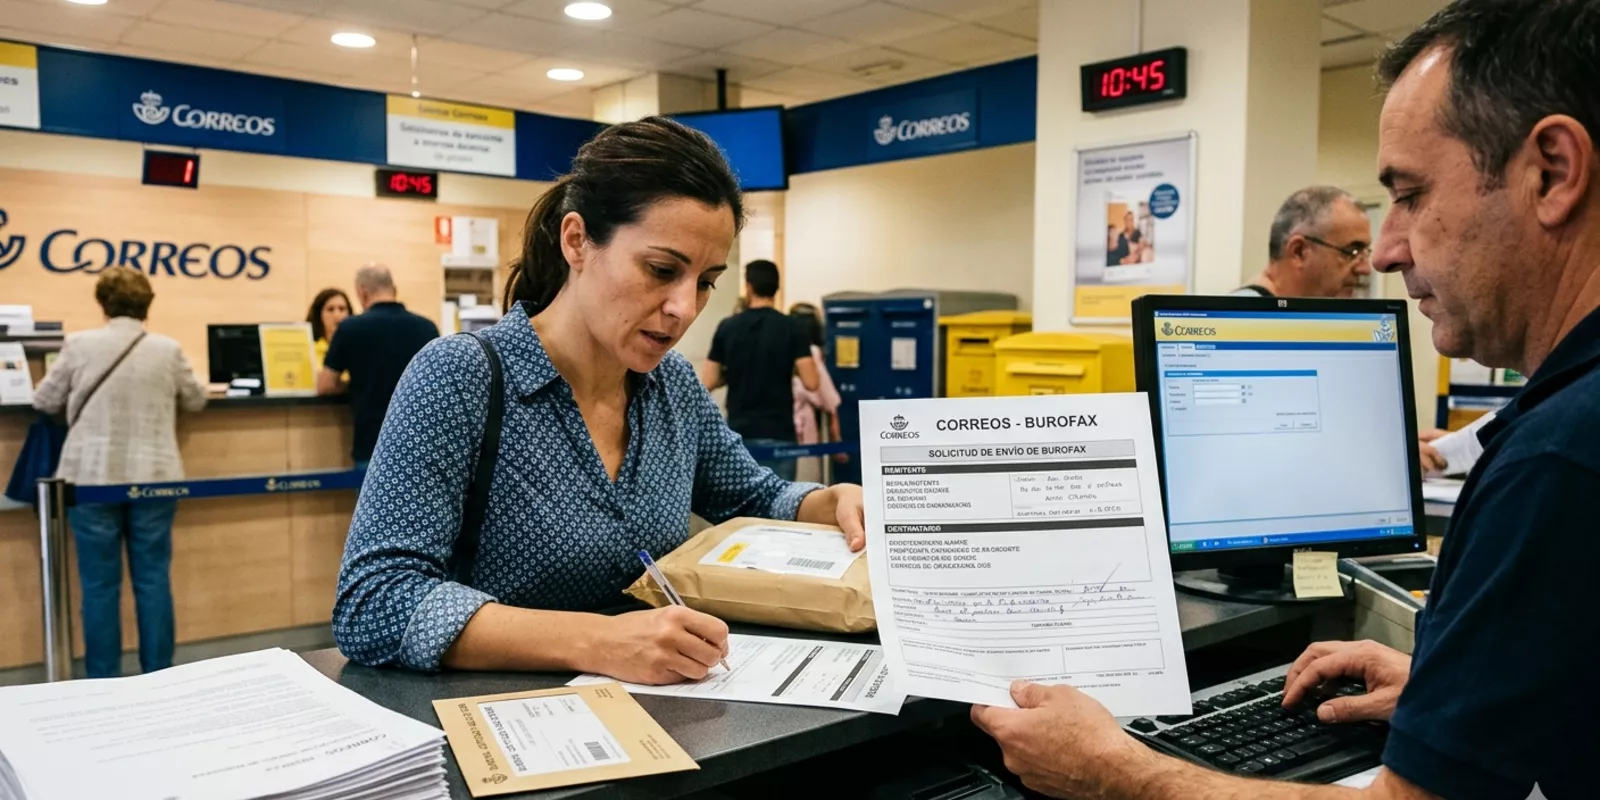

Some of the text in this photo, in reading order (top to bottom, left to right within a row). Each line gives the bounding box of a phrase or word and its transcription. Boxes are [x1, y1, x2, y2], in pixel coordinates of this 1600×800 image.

[1101, 60, 1165, 97] 10:45
[172, 104, 275, 136] CORREOS
[897, 112, 970, 141] CORREOS
[390, 173, 432, 194] 10:45
[39, 229, 272, 280] CORREOS
[936, 418, 1011, 431] CORREOS
[1025, 415, 1098, 428] BUROFAX
[928, 448, 978, 458] SOLICITUD
[980, 447, 993, 456] DE
[1027, 446, 1039, 455] DE
[1042, 445, 1086, 455] BUROFAX
